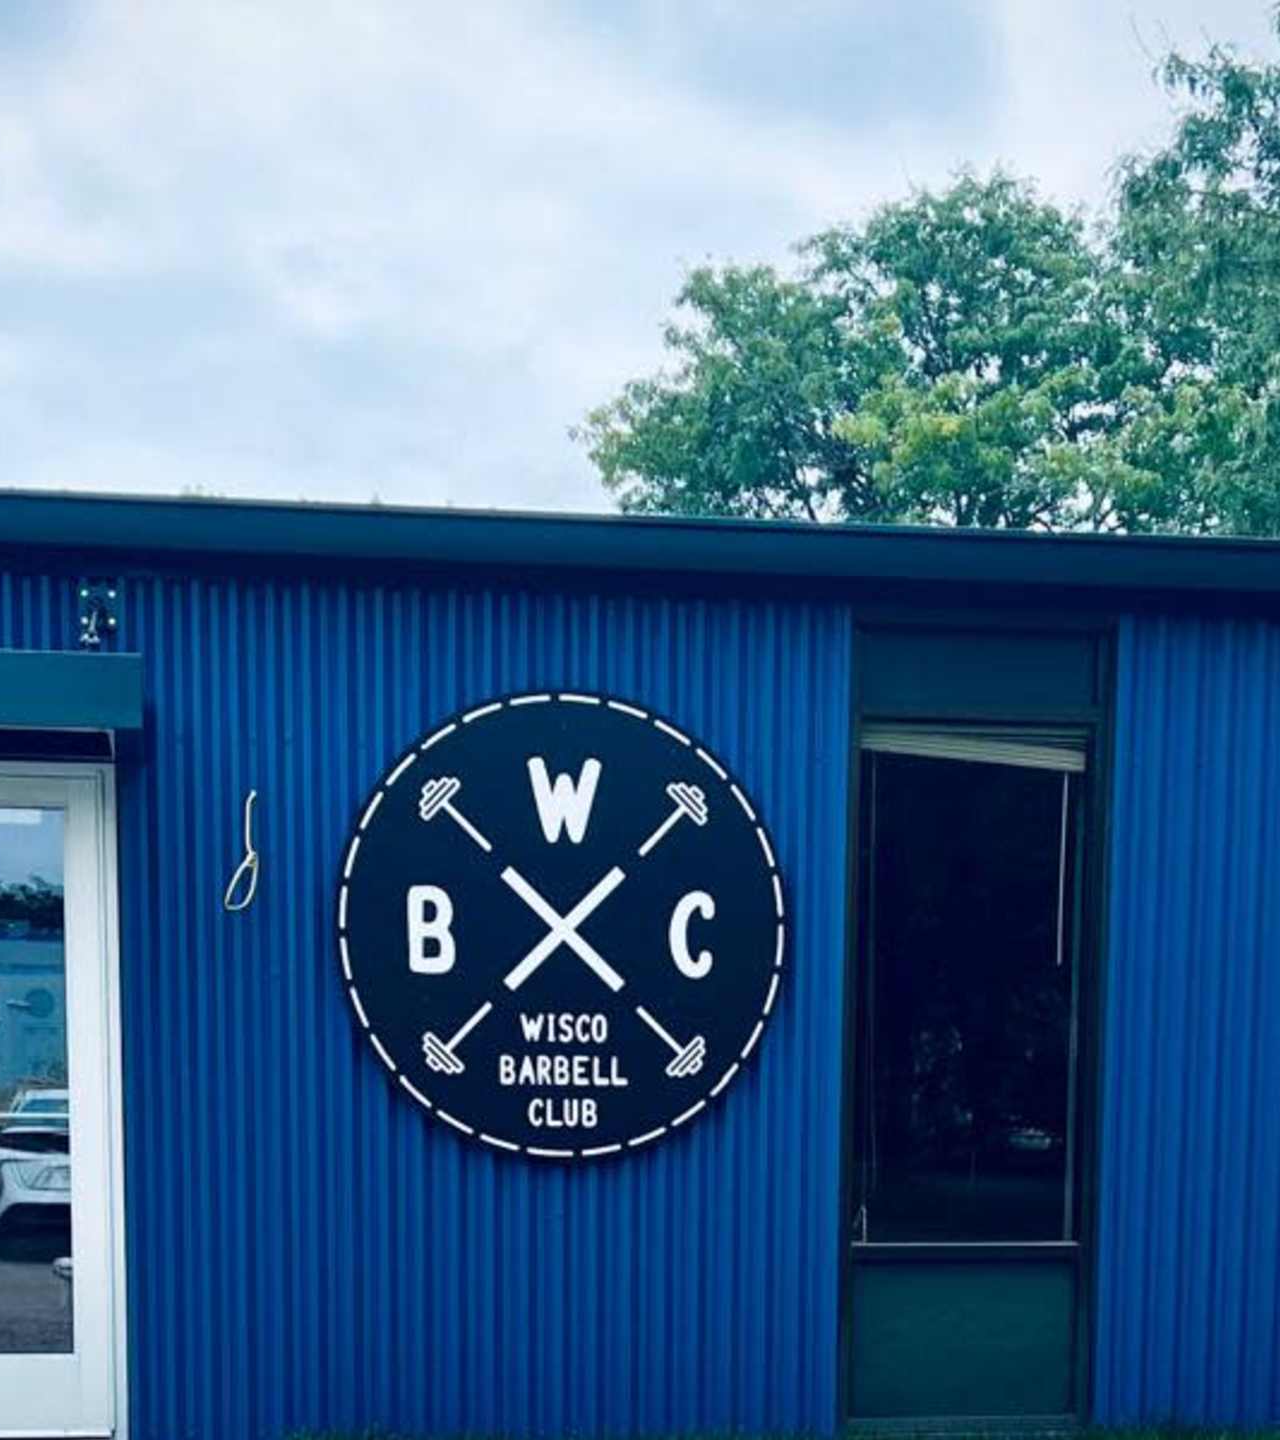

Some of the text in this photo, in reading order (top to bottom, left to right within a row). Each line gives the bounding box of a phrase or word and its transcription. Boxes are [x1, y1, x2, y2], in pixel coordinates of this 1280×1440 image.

[527, 756, 602, 844] W
[406, 884, 456, 975] B
[668, 890, 715, 979] C
[519, 1013, 608, 1044] WISCO
[499, 1054, 629, 1086] BARBELL
[528, 1098, 598, 1128] CLUB
